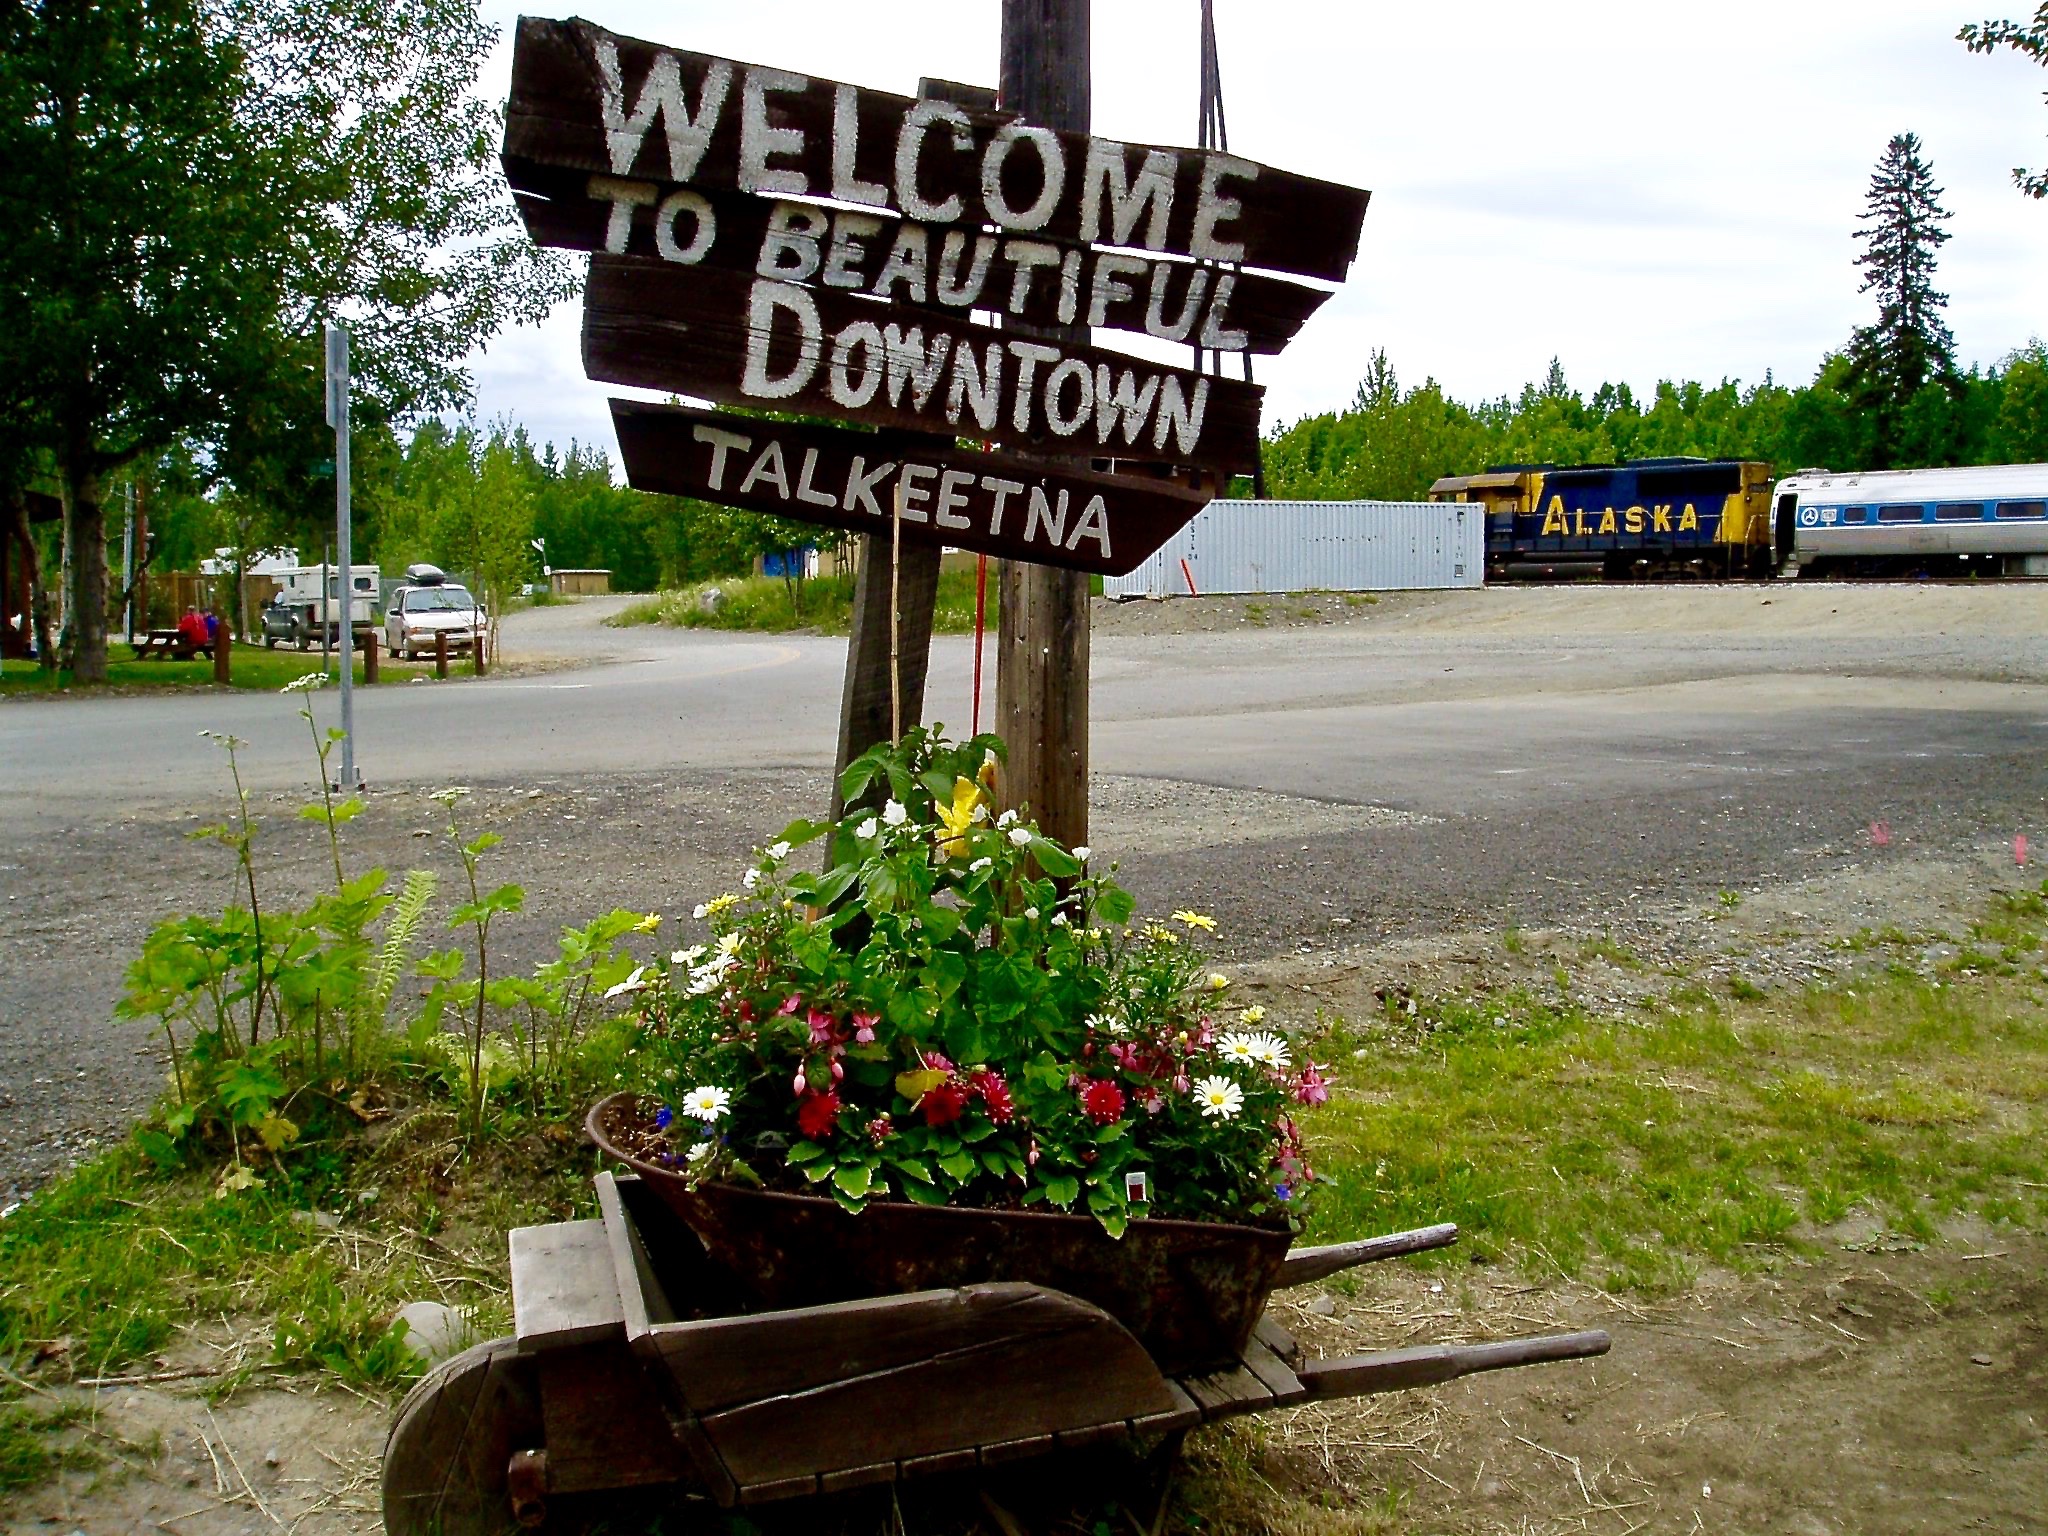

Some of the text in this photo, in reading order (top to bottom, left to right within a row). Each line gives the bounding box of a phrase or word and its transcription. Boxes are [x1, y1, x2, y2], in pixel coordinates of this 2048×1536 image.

[597, 39, 1259, 262] WELCOME
[586, 178, 1250, 351] TO BEAUTIFUL
[741, 280, 1210, 457] DOWNTOWN
[693, 425, 1112, 559] TALKEETNA
[1541, 494, 1697, 536] ALASKA
